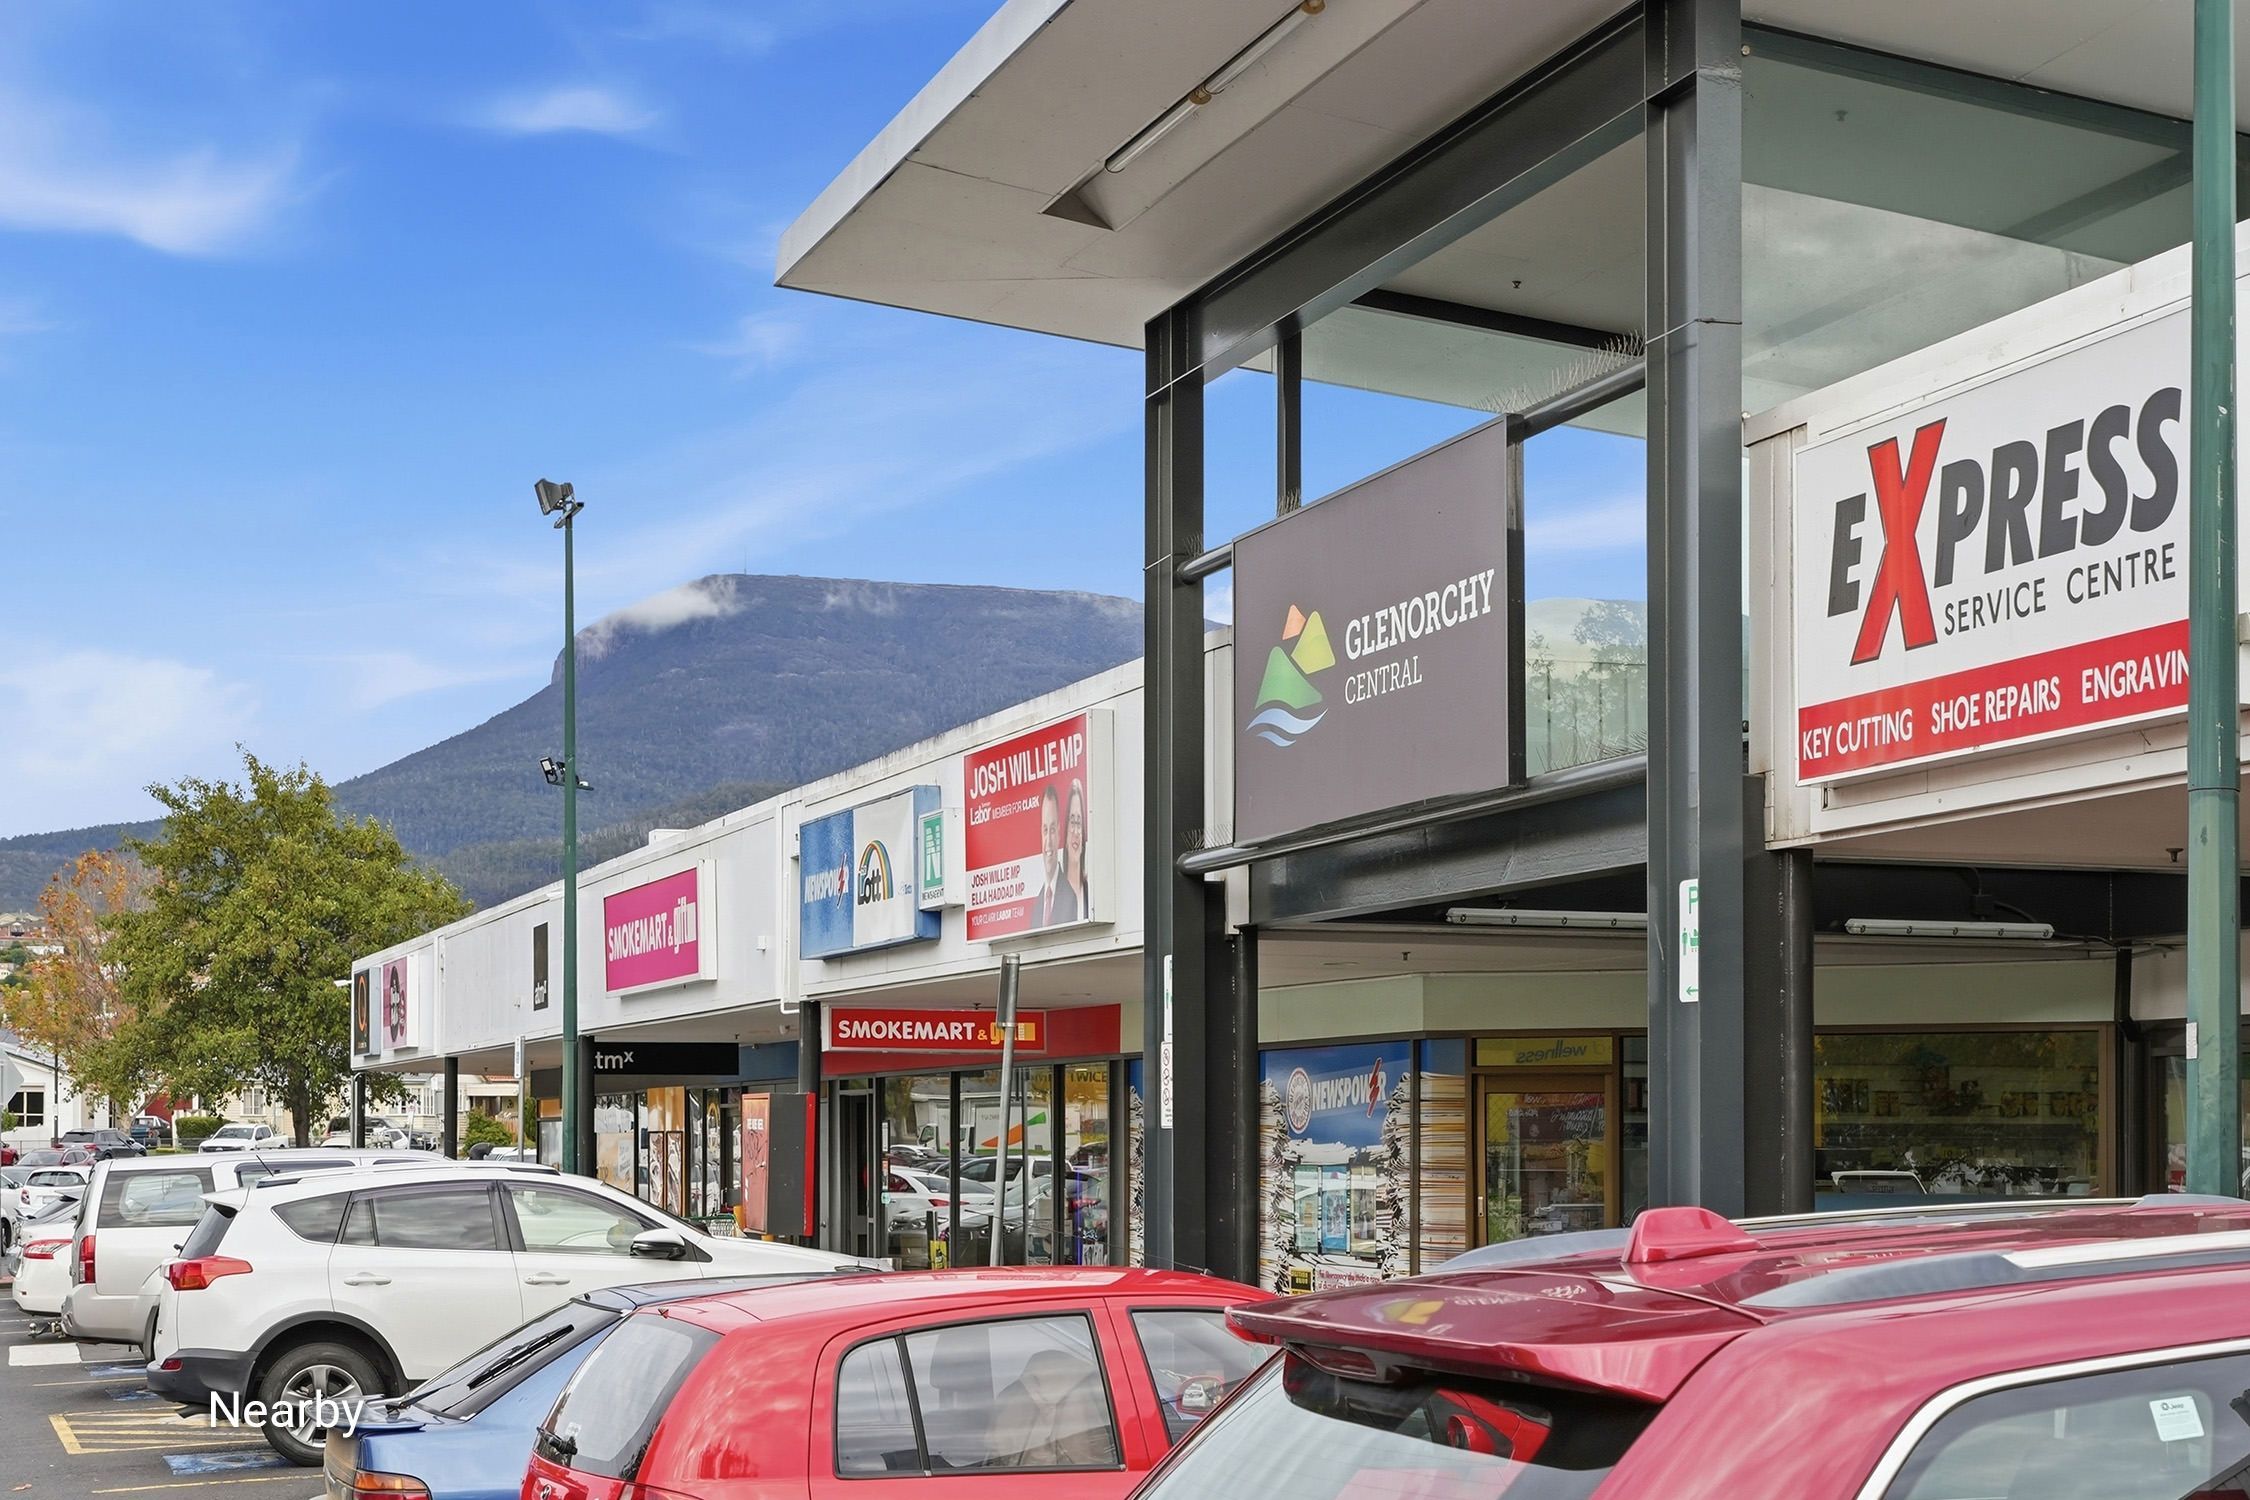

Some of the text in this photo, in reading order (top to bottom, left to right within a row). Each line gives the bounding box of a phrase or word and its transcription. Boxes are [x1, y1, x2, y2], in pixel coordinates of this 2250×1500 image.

[1827, 386, 2182, 667] EXPRESS
[1944, 541, 2176, 636] SERVICE CENTRE
[1345, 568, 1495, 661] GLENORCHY
[1345, 655, 1423, 705] CENTRAL
[1803, 724, 1836, 760] KEY
[1836, 708, 1913, 754] CUTTING
[1931, 693, 1980, 735] SHOE
[1984, 676, 2061, 722] REPAIRS
[970, 732, 1083, 799] JOSH WILLIE MP
[970, 804, 991, 826] Labor
[857, 867, 882, 905] Lott
[971, 864, 1021, 889] JOSH WILLIE MP
[971, 882, 1025, 906] ELLA HADDAD MP
[608, 912, 668, 961] SMOKEMART
[668, 925, 674, 947] &
[838, 1020, 975, 1041] SMOKEMART
[977, 1028, 988, 1041] &
